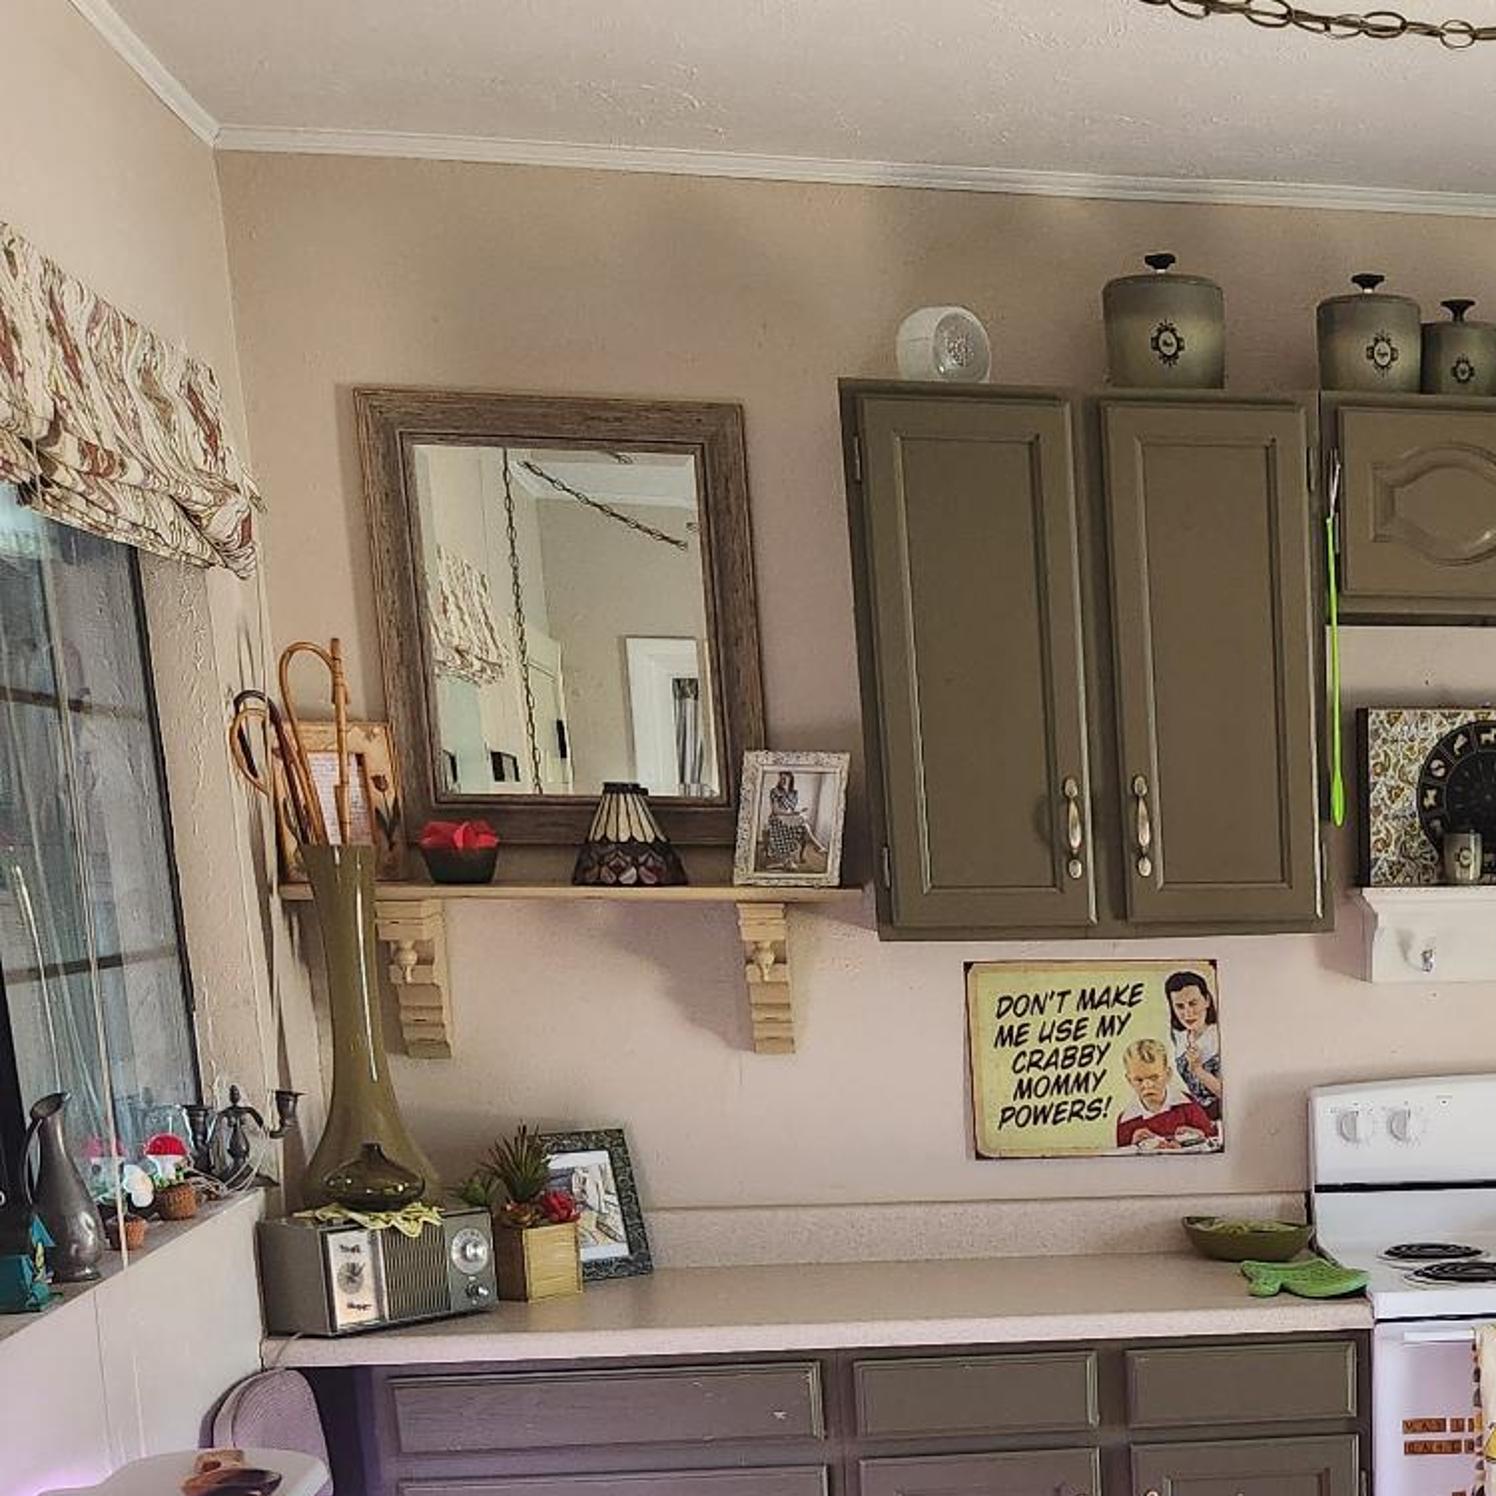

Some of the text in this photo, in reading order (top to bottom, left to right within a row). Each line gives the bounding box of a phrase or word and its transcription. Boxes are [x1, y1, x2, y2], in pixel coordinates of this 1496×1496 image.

[995, 983, 1145, 1020] DON'T MAKE
[994, 1012, 1132, 1049] ME USE MY
[1012, 1042, 1112, 1074] CRABBY
[1013, 1069, 1107, 1101] MOMMY
[998, 1096, 1113, 1131] POWERS!
